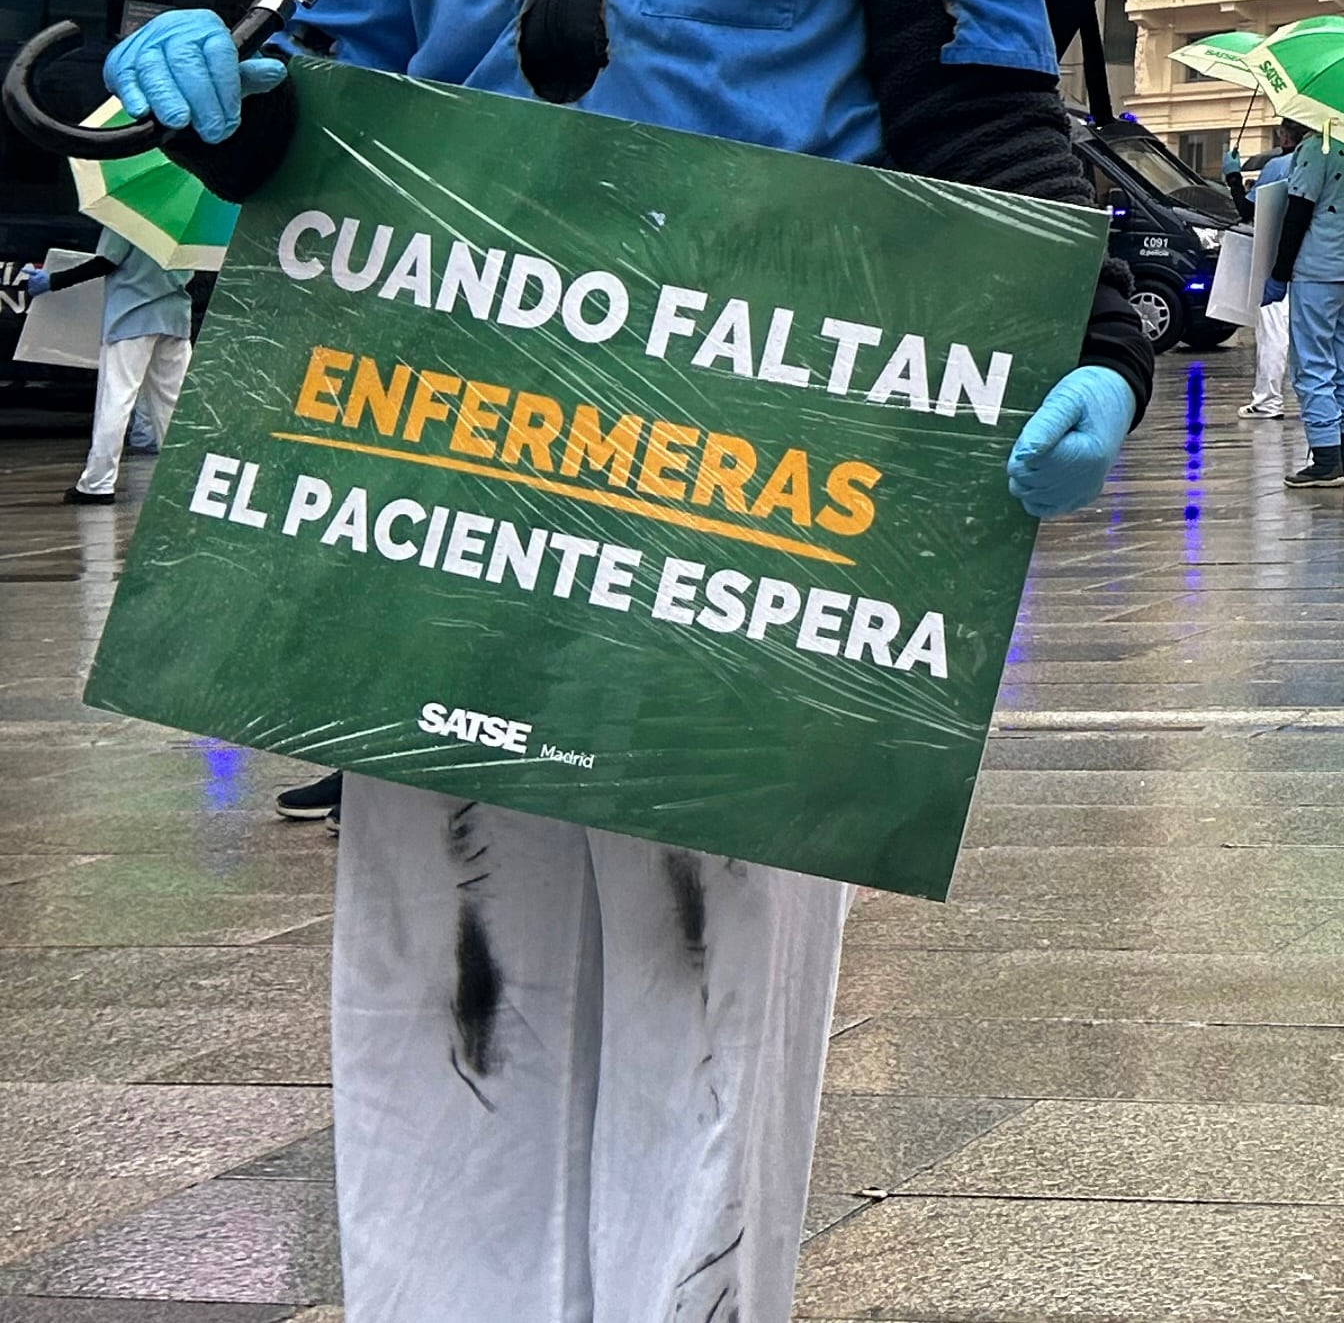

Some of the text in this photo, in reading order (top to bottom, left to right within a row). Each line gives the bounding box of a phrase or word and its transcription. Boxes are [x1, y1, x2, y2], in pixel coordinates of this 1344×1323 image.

[1258, 59, 1288, 94] SATSE
[277, 209, 1014, 427] CUANDO FALTAN
[293, 345, 883, 536] ENFERMERAS
[188, 452, 949, 679] EL PACIENTE ESPERA
[417, 702, 596, 770] SATSE Madrid
